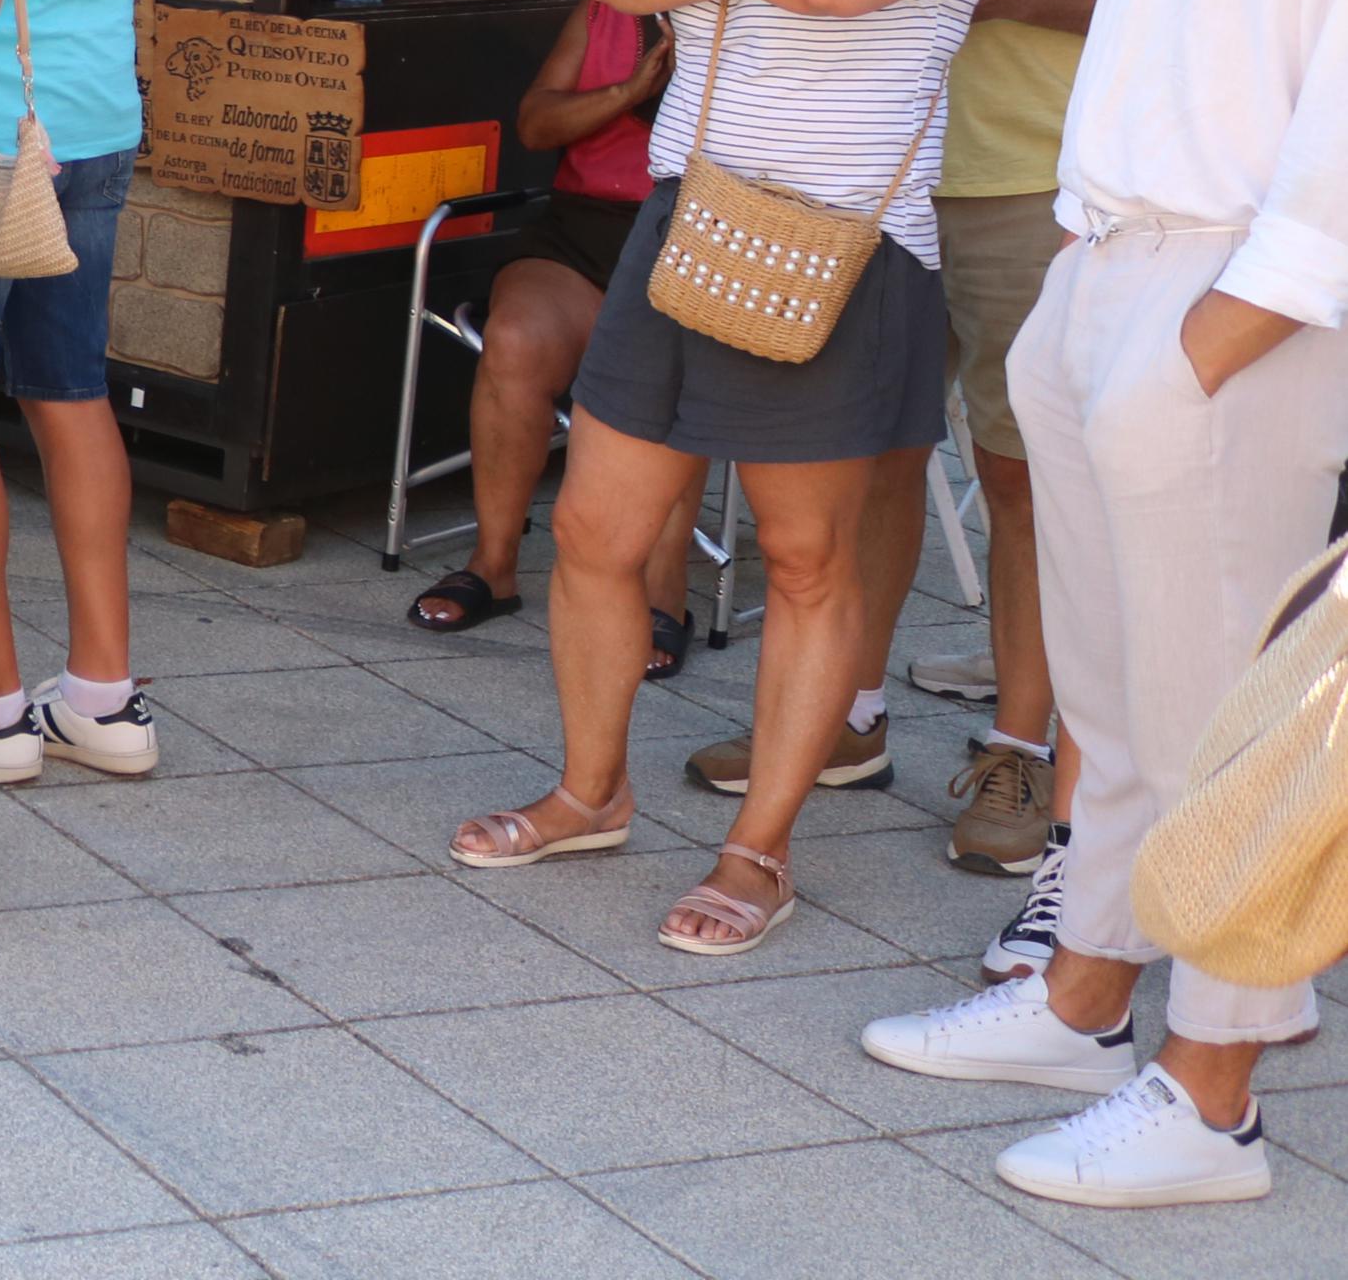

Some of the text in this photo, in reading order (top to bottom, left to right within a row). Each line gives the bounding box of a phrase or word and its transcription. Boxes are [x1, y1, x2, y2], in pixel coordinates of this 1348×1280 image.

[229, 18, 347, 41] EL REY DE LA CECINA
[226, 61, 347, 92] PURO DE OVEJA
[175, 112, 213, 127] EL REY
[221, 103, 298, 133] Elaborado
[156, 129, 229, 150] DE LA CECINA
[229, 137, 295, 166] de forma
[164, 154, 207, 173] Astorga
[222, 167, 296, 196] tradicional
